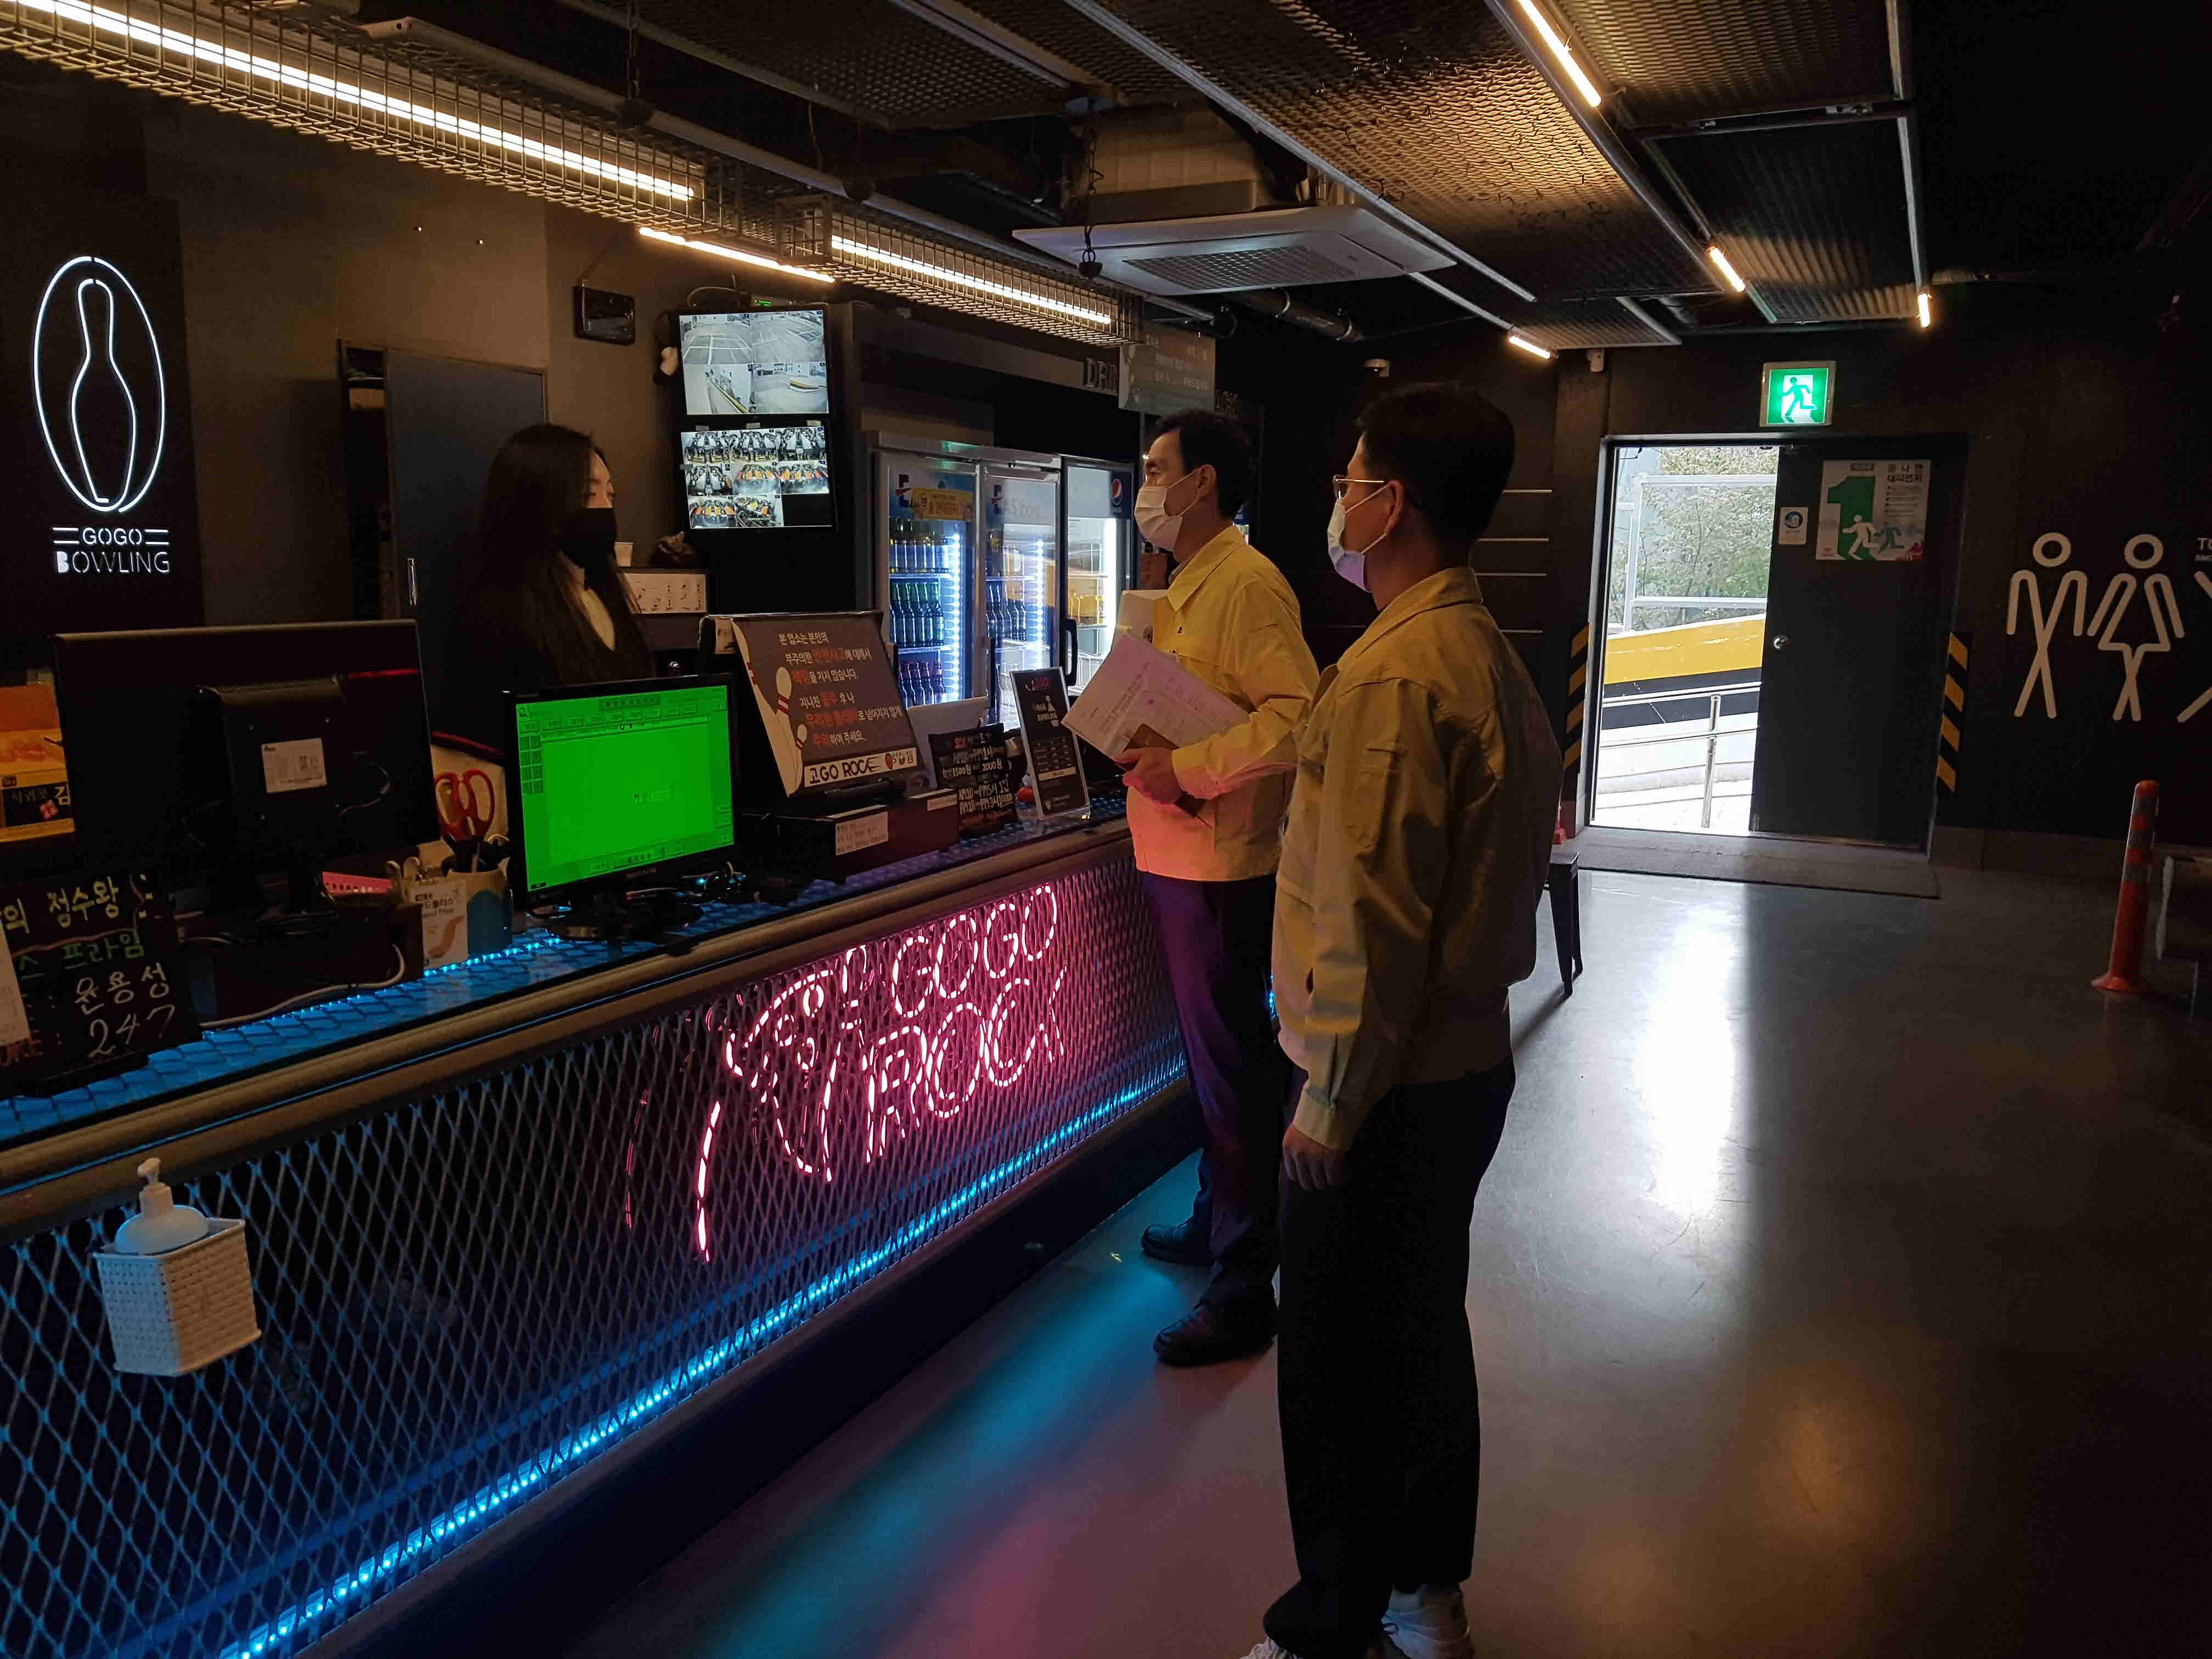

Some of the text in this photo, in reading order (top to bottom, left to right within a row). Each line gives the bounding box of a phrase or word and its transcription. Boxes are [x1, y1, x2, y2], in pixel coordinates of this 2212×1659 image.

[82, 527, 143, 546] GOGO
[57, 550, 171, 574] BOWLING
[787, 633, 808, 645] 업소는
[808, 632, 829, 645] 본인의
[46, 876, 119, 928] 점수왕
